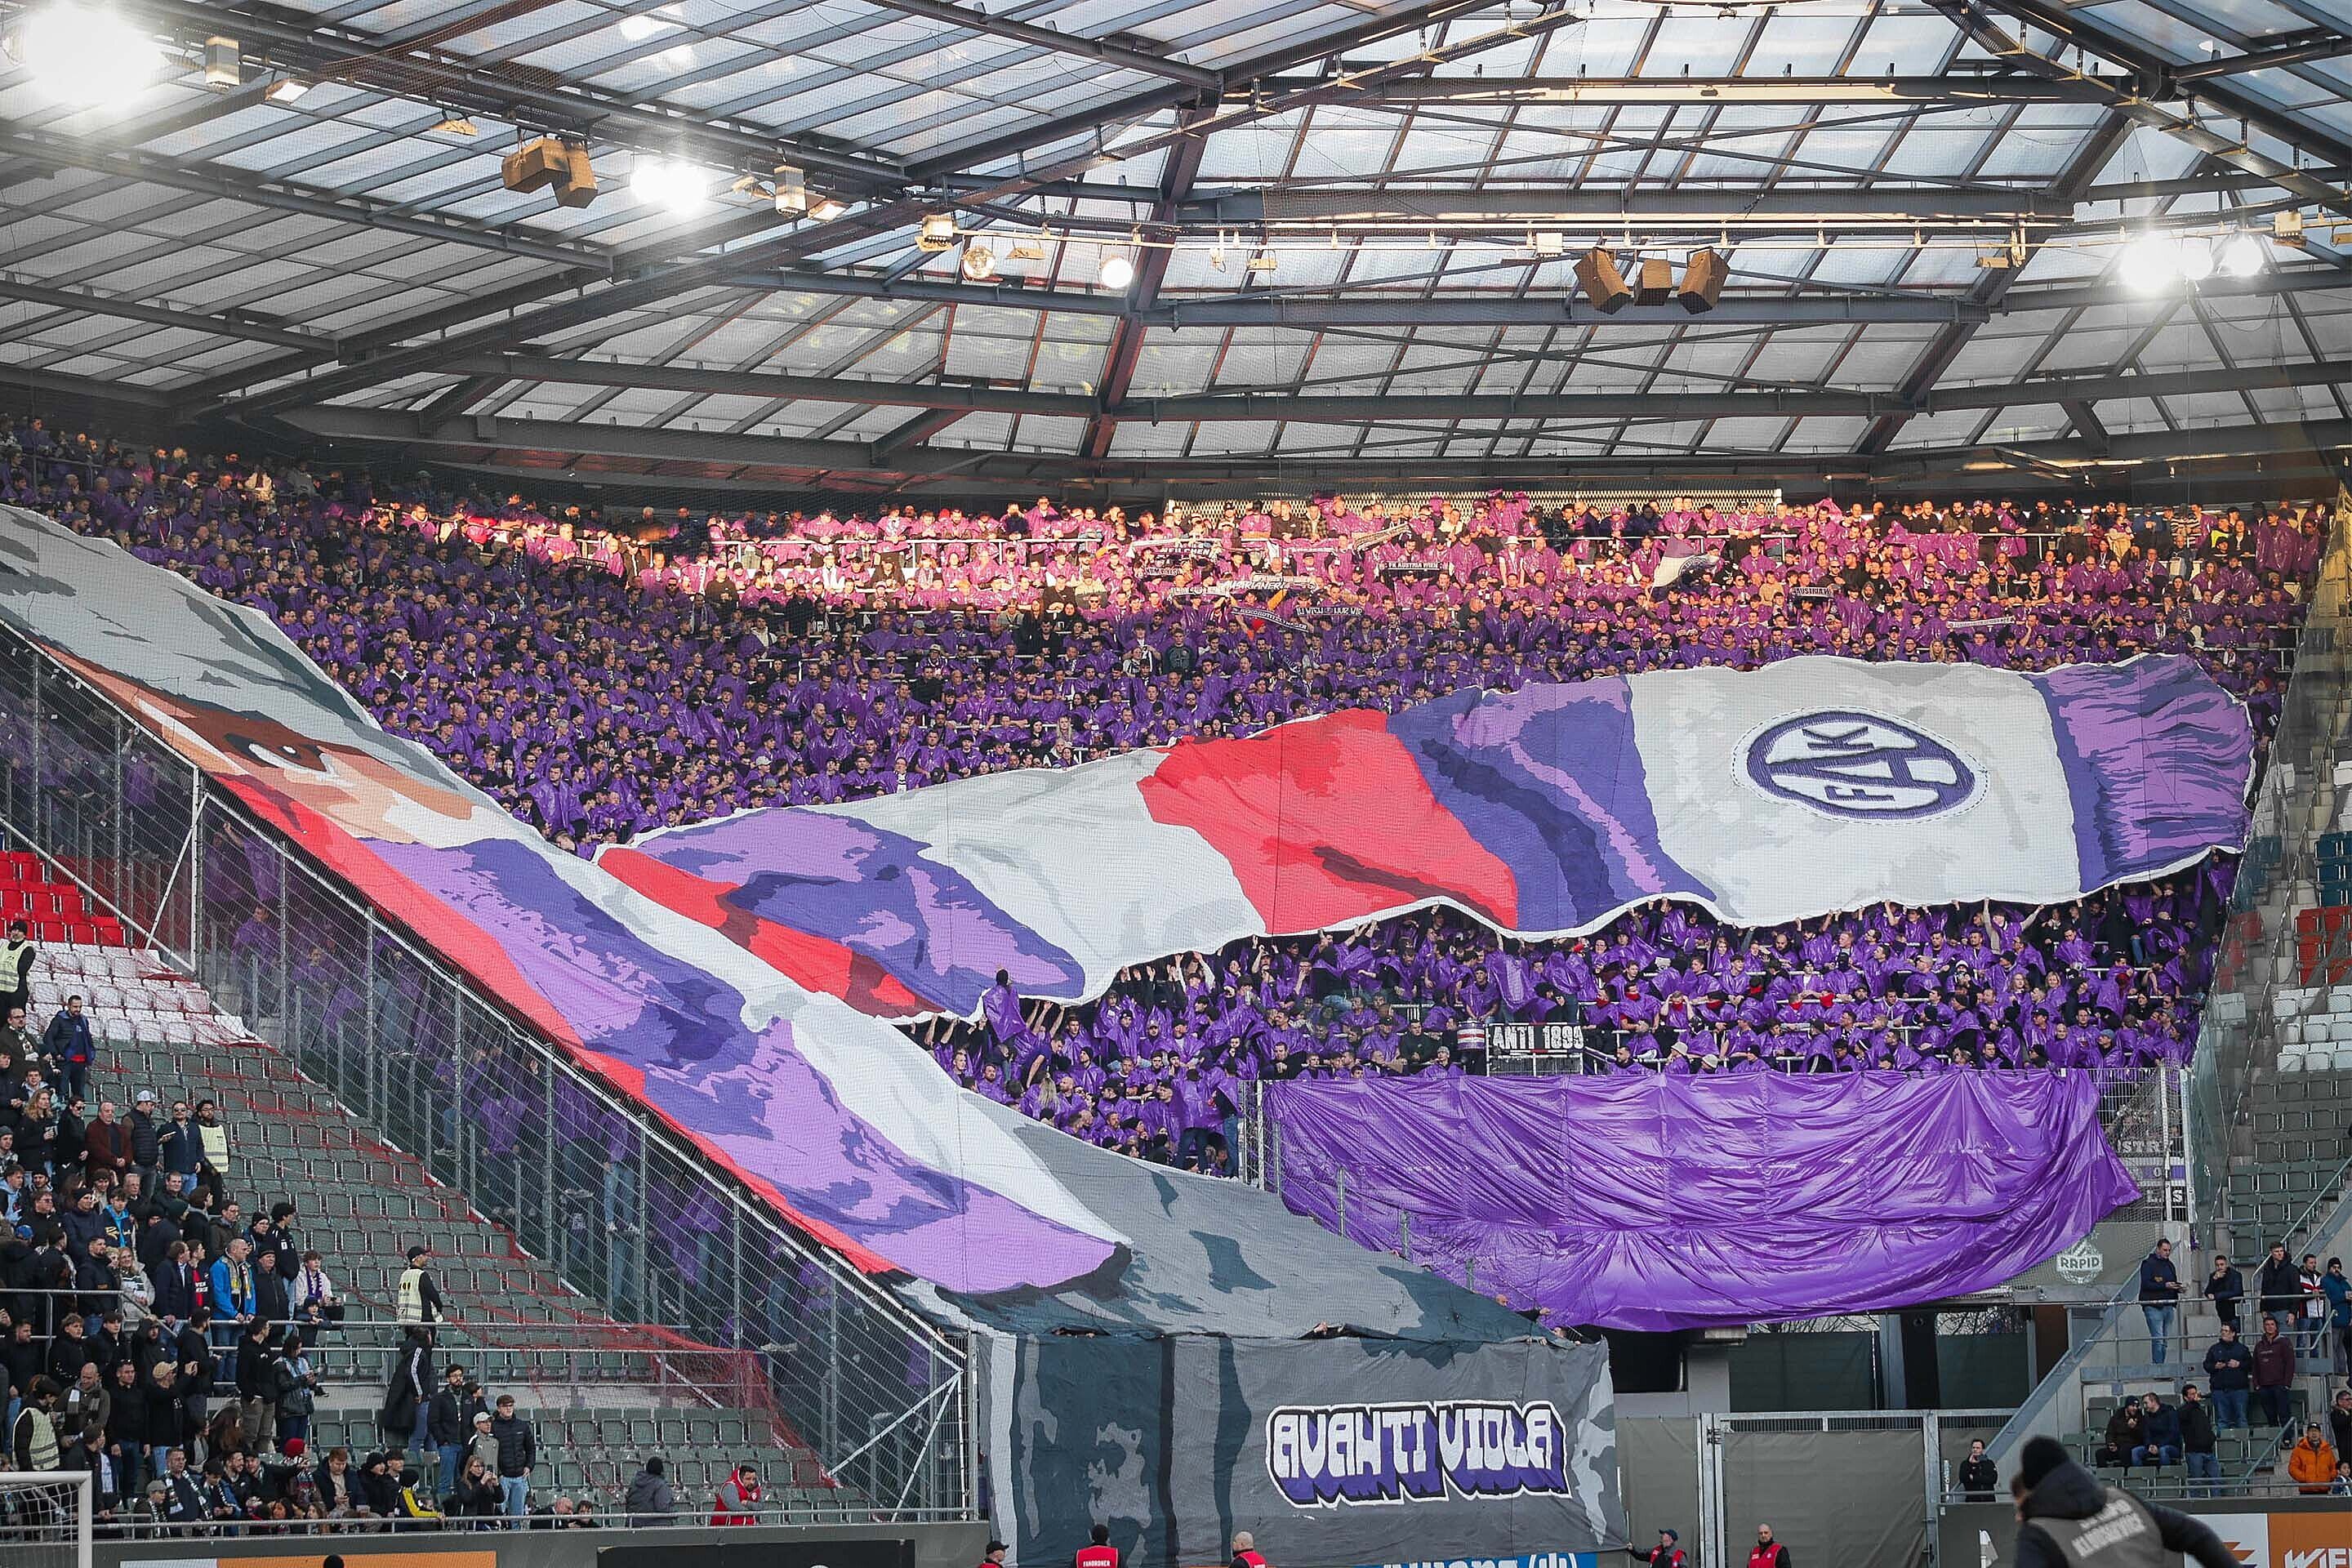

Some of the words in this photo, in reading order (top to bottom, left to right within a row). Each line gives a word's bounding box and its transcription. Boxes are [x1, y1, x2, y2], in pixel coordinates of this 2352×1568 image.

[1493, 1026, 1535, 1049] ANTI
[2060, 1256, 2100, 1269] RAPID
[1268, 1405, 1441, 1494] AVANTI
[1437, 1403, 1561, 1486] VIOLA
[2284, 1548, 2352, 1568] WIE
